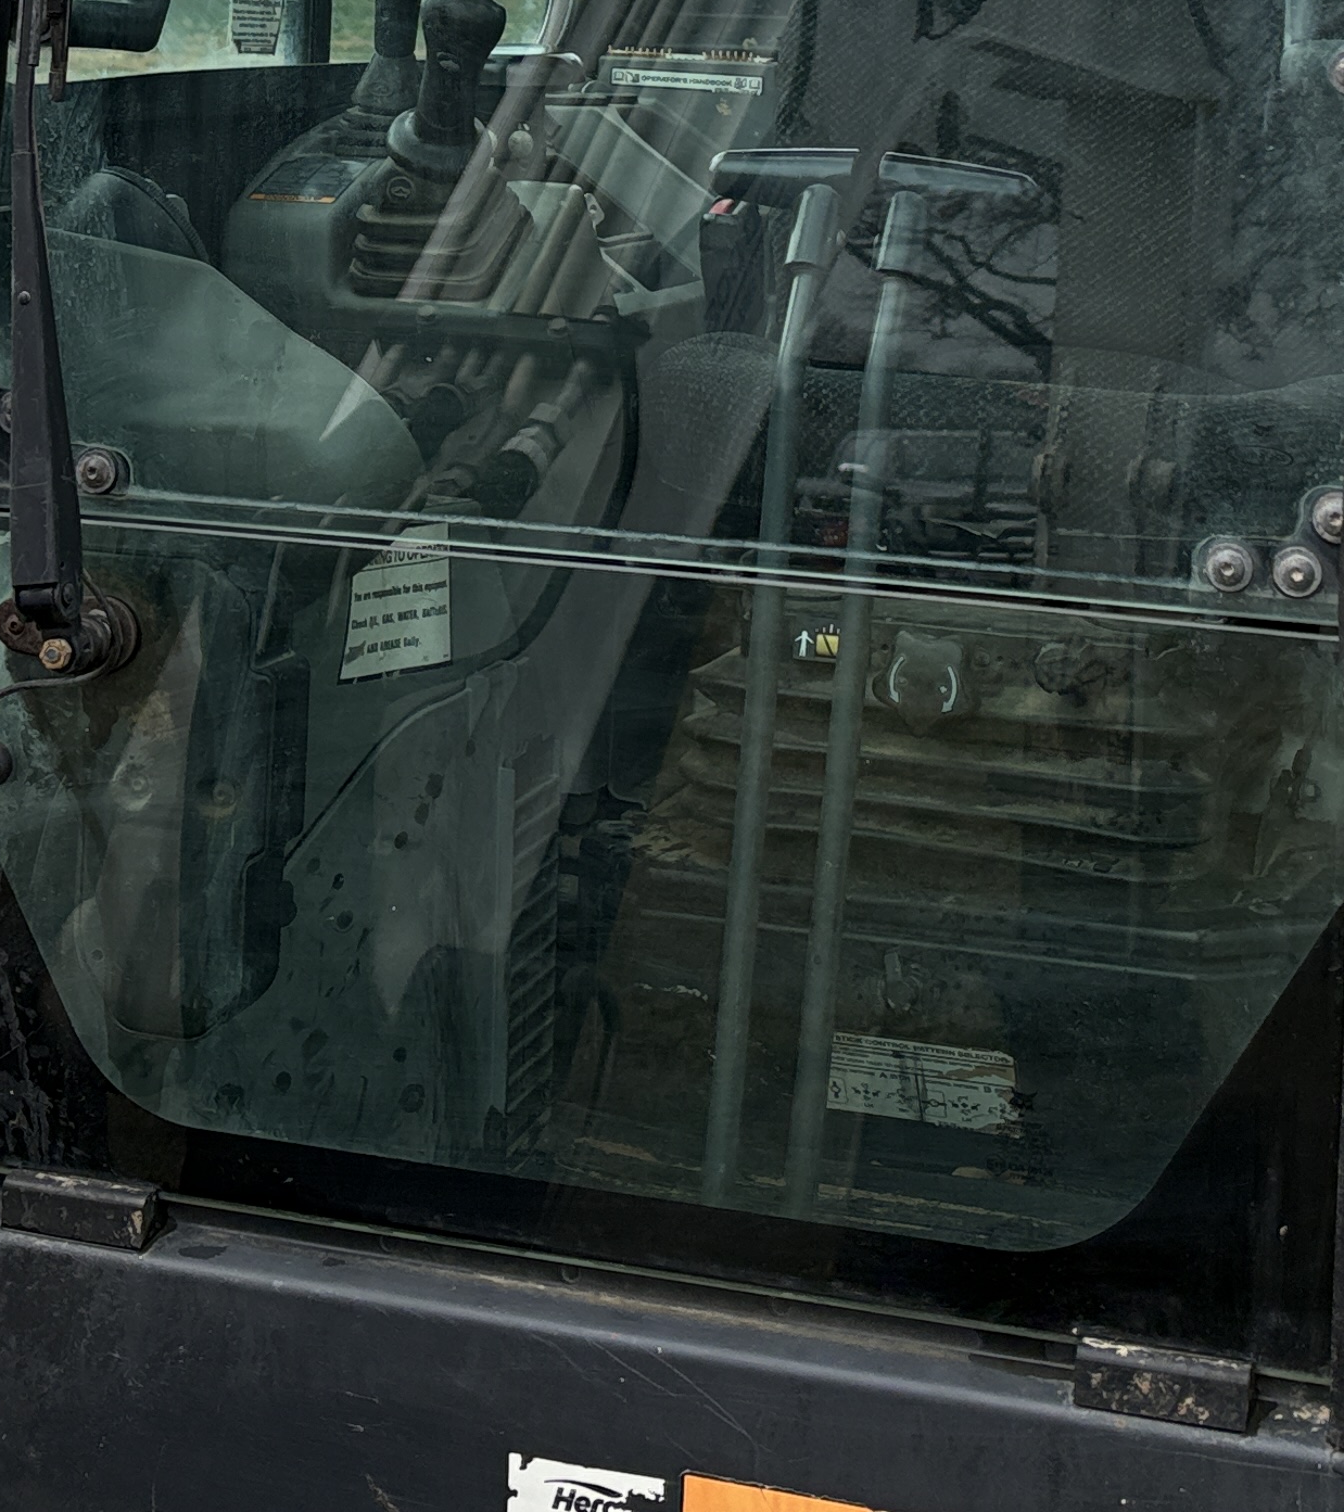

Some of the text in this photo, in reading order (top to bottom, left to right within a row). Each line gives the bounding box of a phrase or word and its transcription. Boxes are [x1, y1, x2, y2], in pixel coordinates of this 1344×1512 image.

[689, 78, 732, 87] HANDBOOK
[372, 586, 402, 599] responsible
[403, 584, 411, 593] for
[412, 583, 423, 592] this
[352, 619, 367, 630] Check
[863, 1039, 912, 1051] CONTROL
[913, 1045, 956, 1057] PATTERN
[957, 1050, 1011, 1064] SELECTOR
